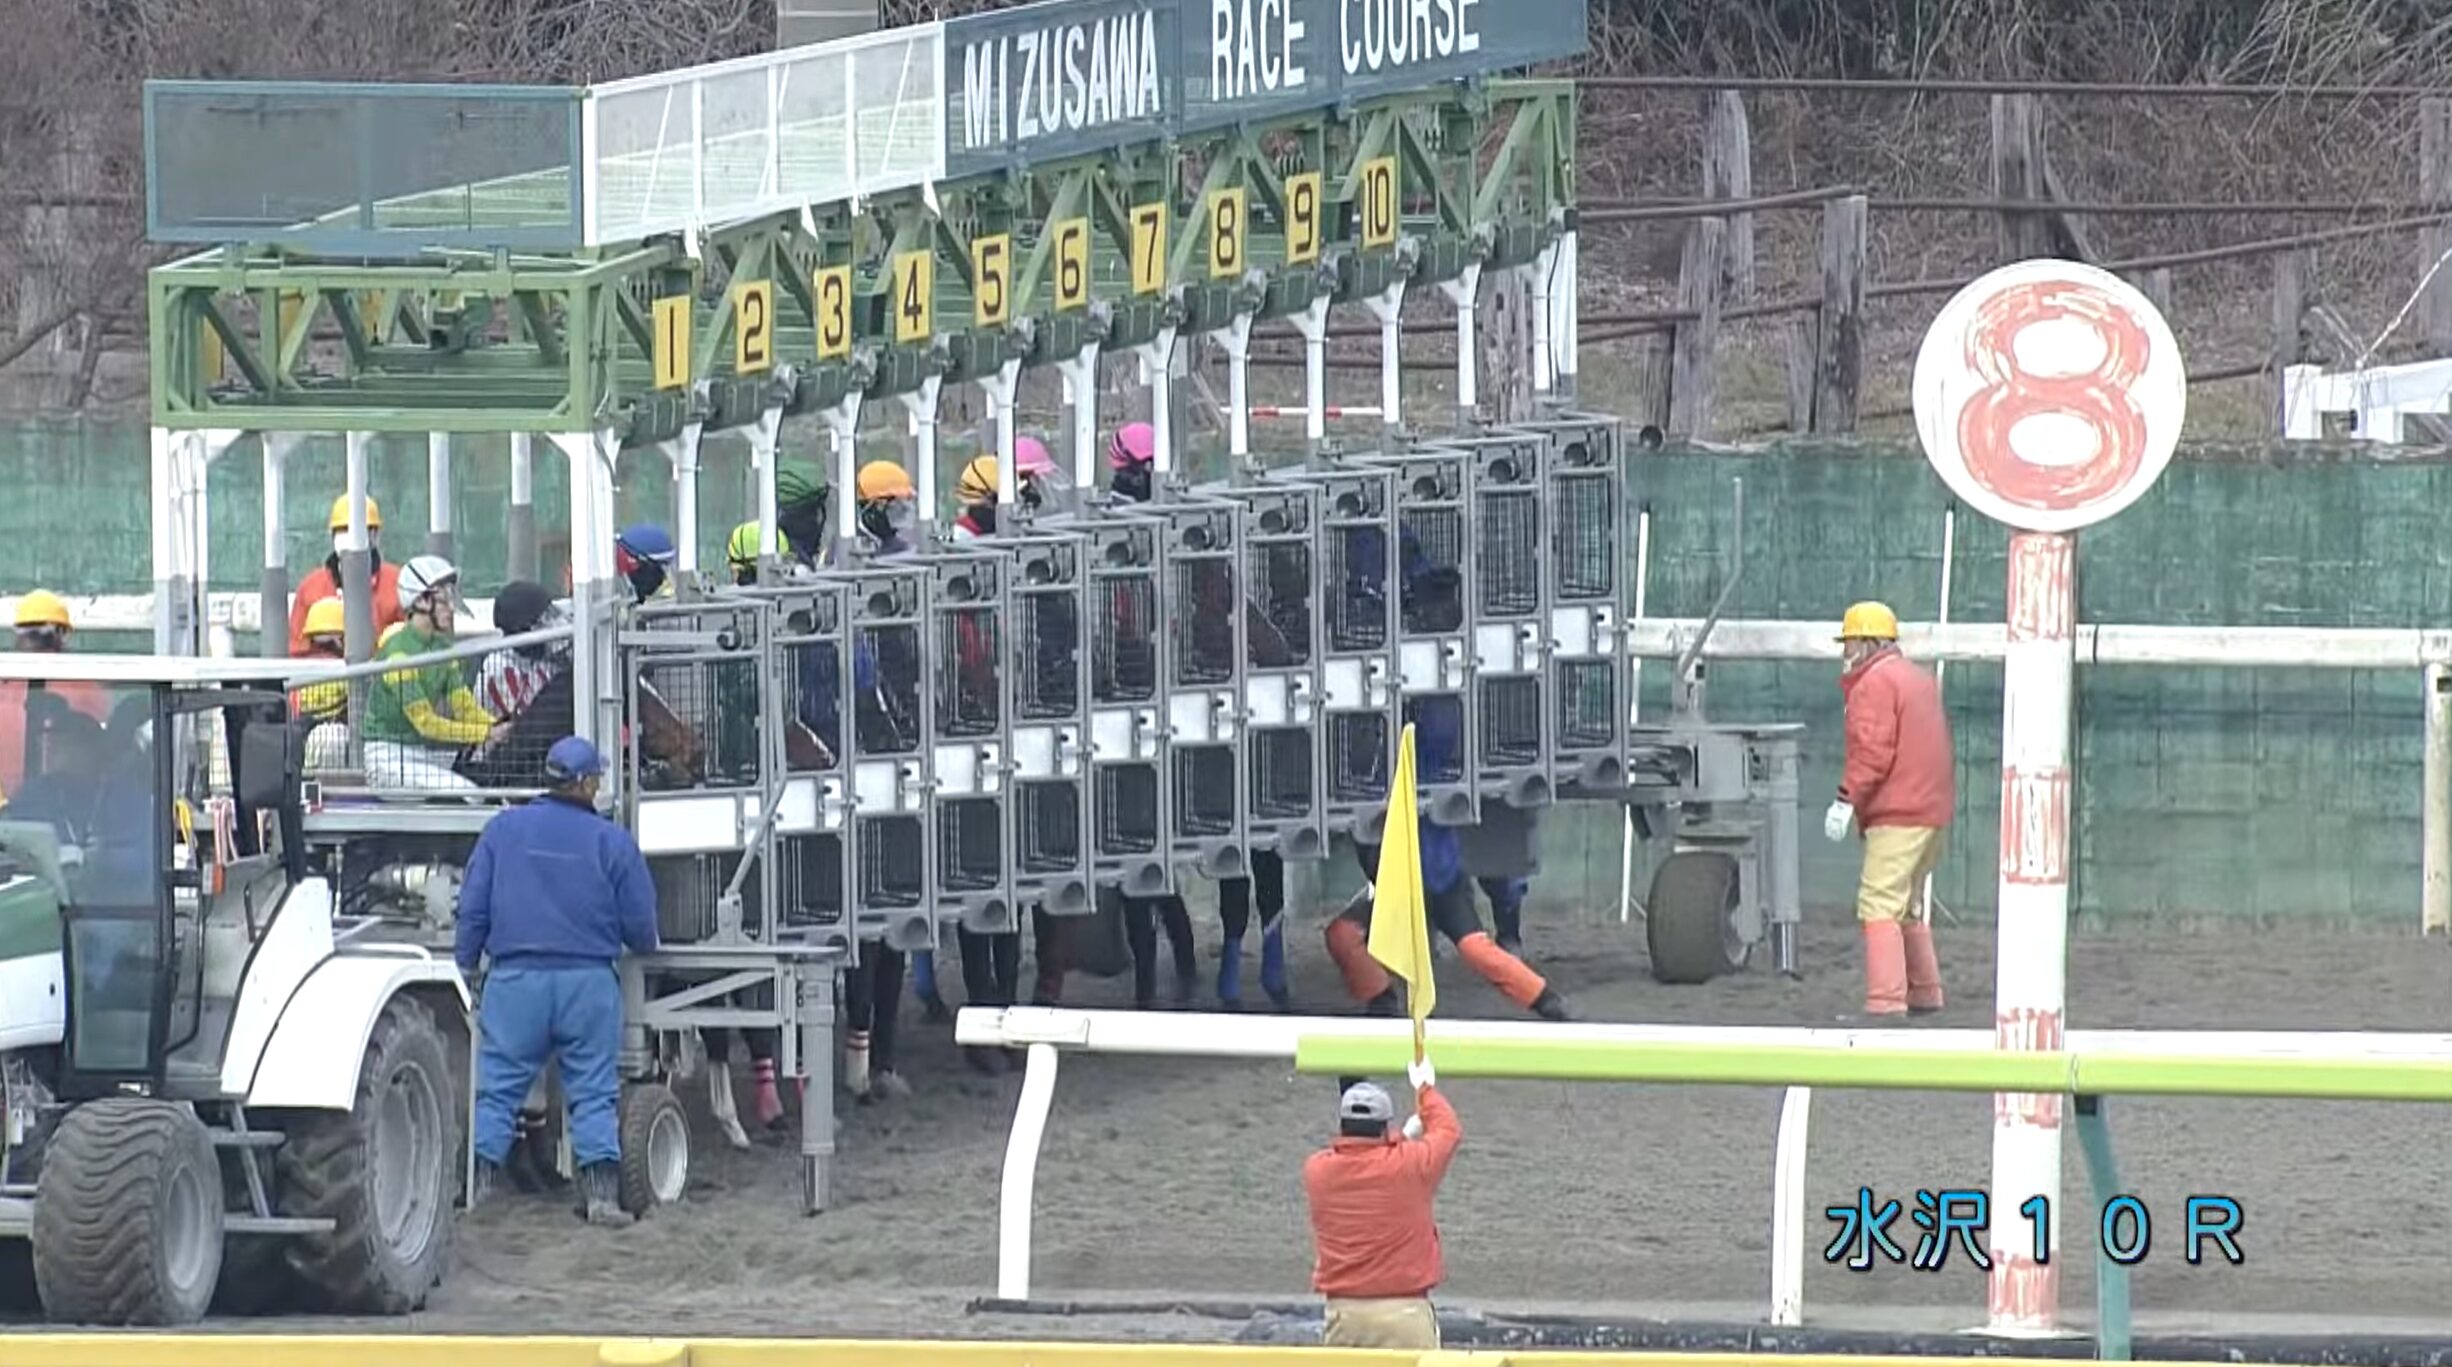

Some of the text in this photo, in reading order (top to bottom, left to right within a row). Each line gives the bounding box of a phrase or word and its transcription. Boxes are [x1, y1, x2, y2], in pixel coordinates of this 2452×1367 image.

[963, 0, 1480, 148] MIZUSAWA RACE COURSE
[1217, 197, 1236, 268] 8
[1294, 182, 1313, 253] 9
[1368, 163, 1391, 239] 10
[982, 243, 1002, 317] 5
[1061, 228, 1081, 299] 6
[1139, 212, 1158, 284] 7
[744, 289, 764, 362] 2
[824, 275, 844, 347] 3
[904, 260, 923, 332] 4
[1957, 280, 2150, 511] 8
